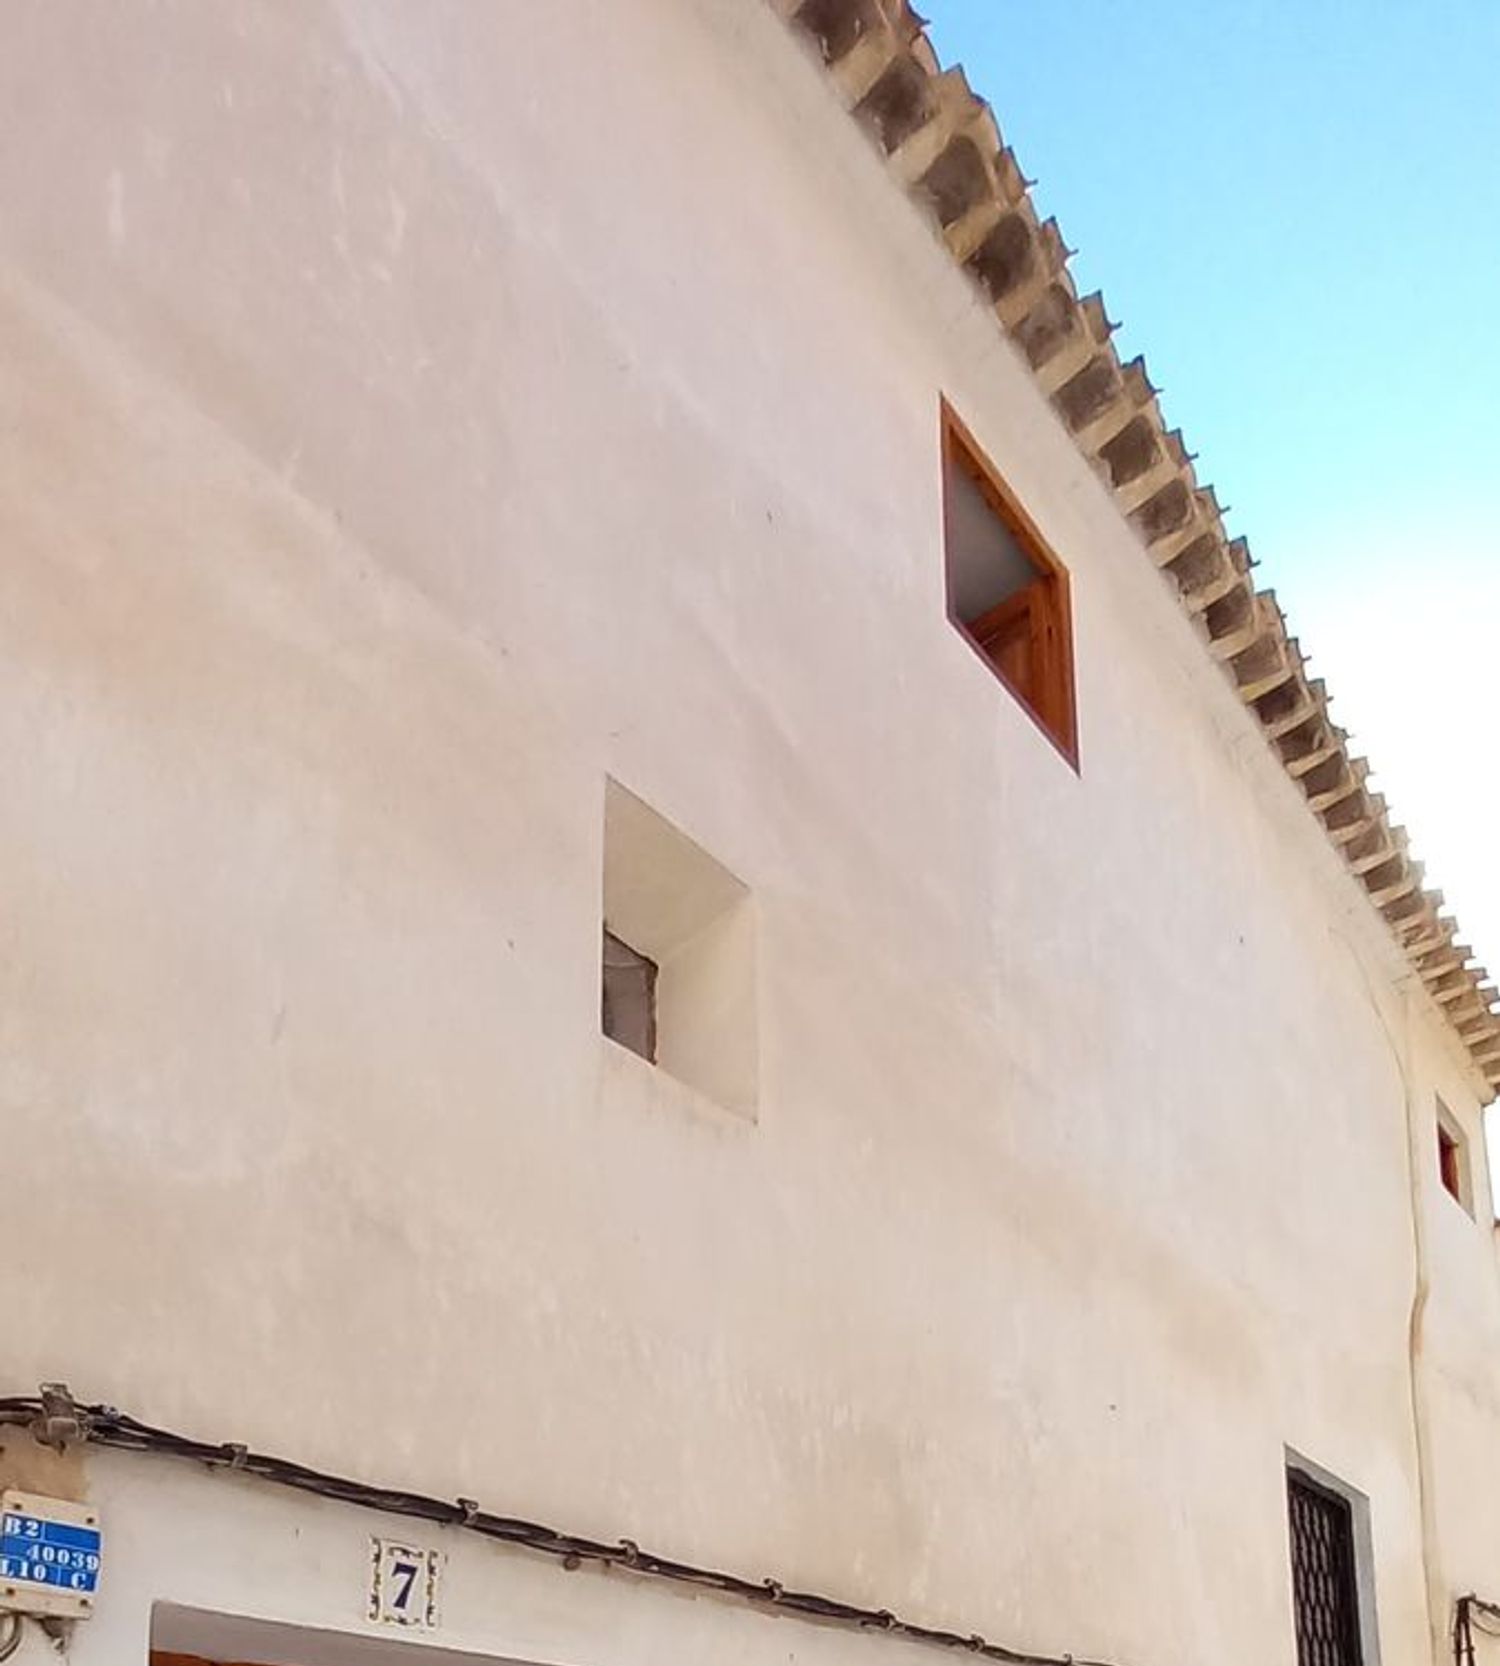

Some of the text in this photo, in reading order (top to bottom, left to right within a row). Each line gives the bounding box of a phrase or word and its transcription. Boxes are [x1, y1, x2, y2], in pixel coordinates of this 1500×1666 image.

[26, 1543, 99, 1571] 40039
[70, 1571, 87, 1589] C
[391, 1562, 418, 1609] 7
